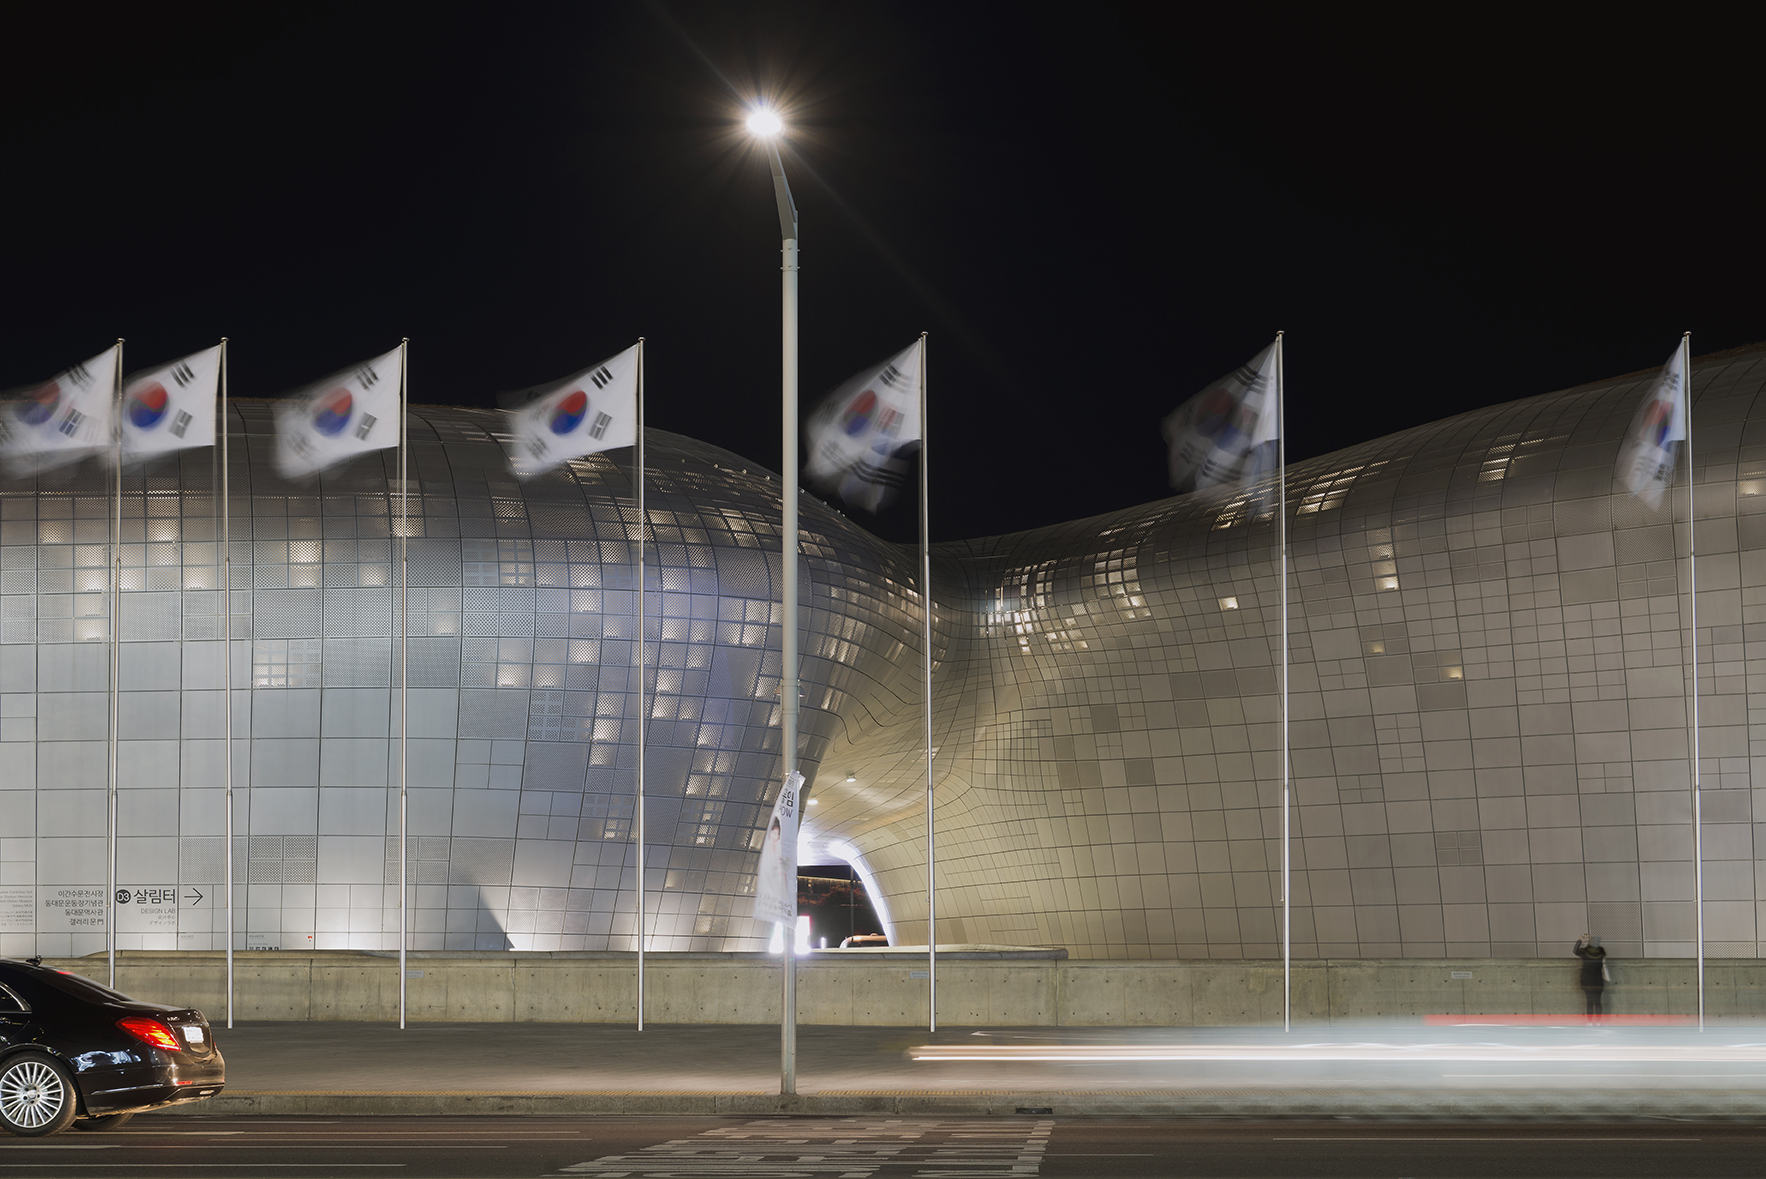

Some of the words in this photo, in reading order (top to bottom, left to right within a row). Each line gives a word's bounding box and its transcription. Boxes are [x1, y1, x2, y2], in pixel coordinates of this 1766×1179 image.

[58, 890, 104, 898] 이간수문전시장
[118, 893, 130, 901] D3
[134, 888, 176, 905] 살림터
[45, 900, 104, 908] 동대문운동장기념관
[65, 909, 104, 917] 동대문역사관
[69, 918, 89, 926] 갤러리
